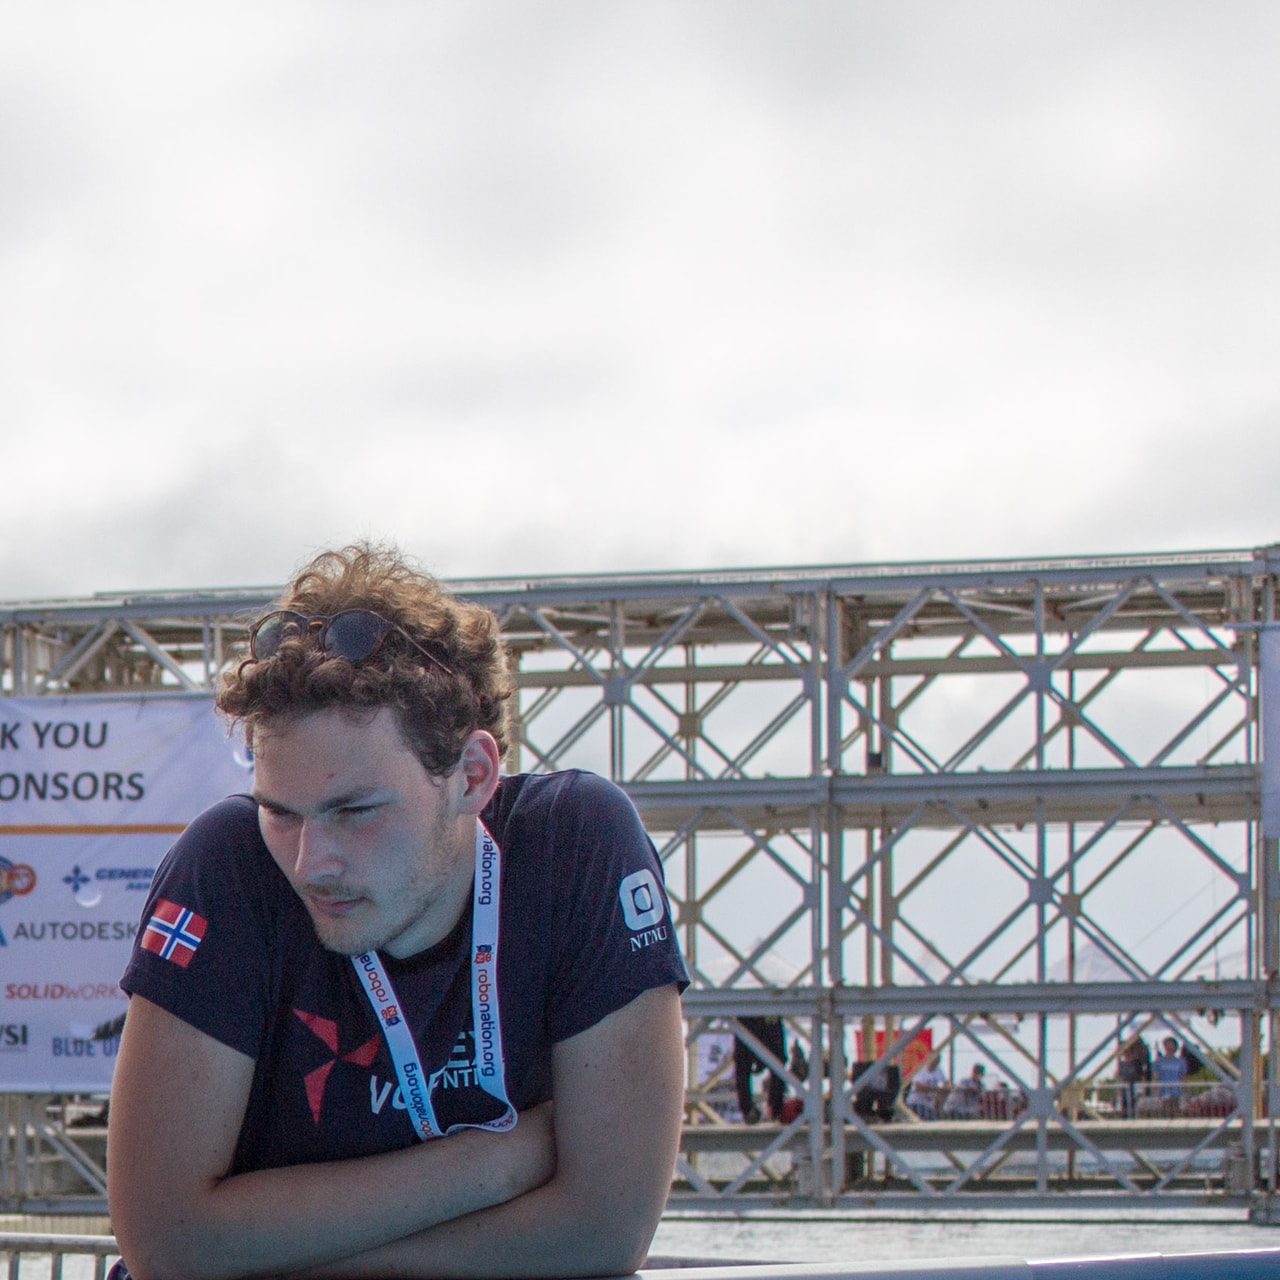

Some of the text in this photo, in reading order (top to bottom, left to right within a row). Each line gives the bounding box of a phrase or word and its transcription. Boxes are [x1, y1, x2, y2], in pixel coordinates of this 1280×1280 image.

[32, 721, 108, 749] YOU
[478, 829, 497, 905] nation.org
[13, 921, 138, 940] AUTODESK
[630, 926, 668, 952] NTNU
[5, 982, 128, 999] SOLIDWORK
[478, 968, 497, 1077] robonation.org
[403, 1062, 435, 1137] obonation.org
